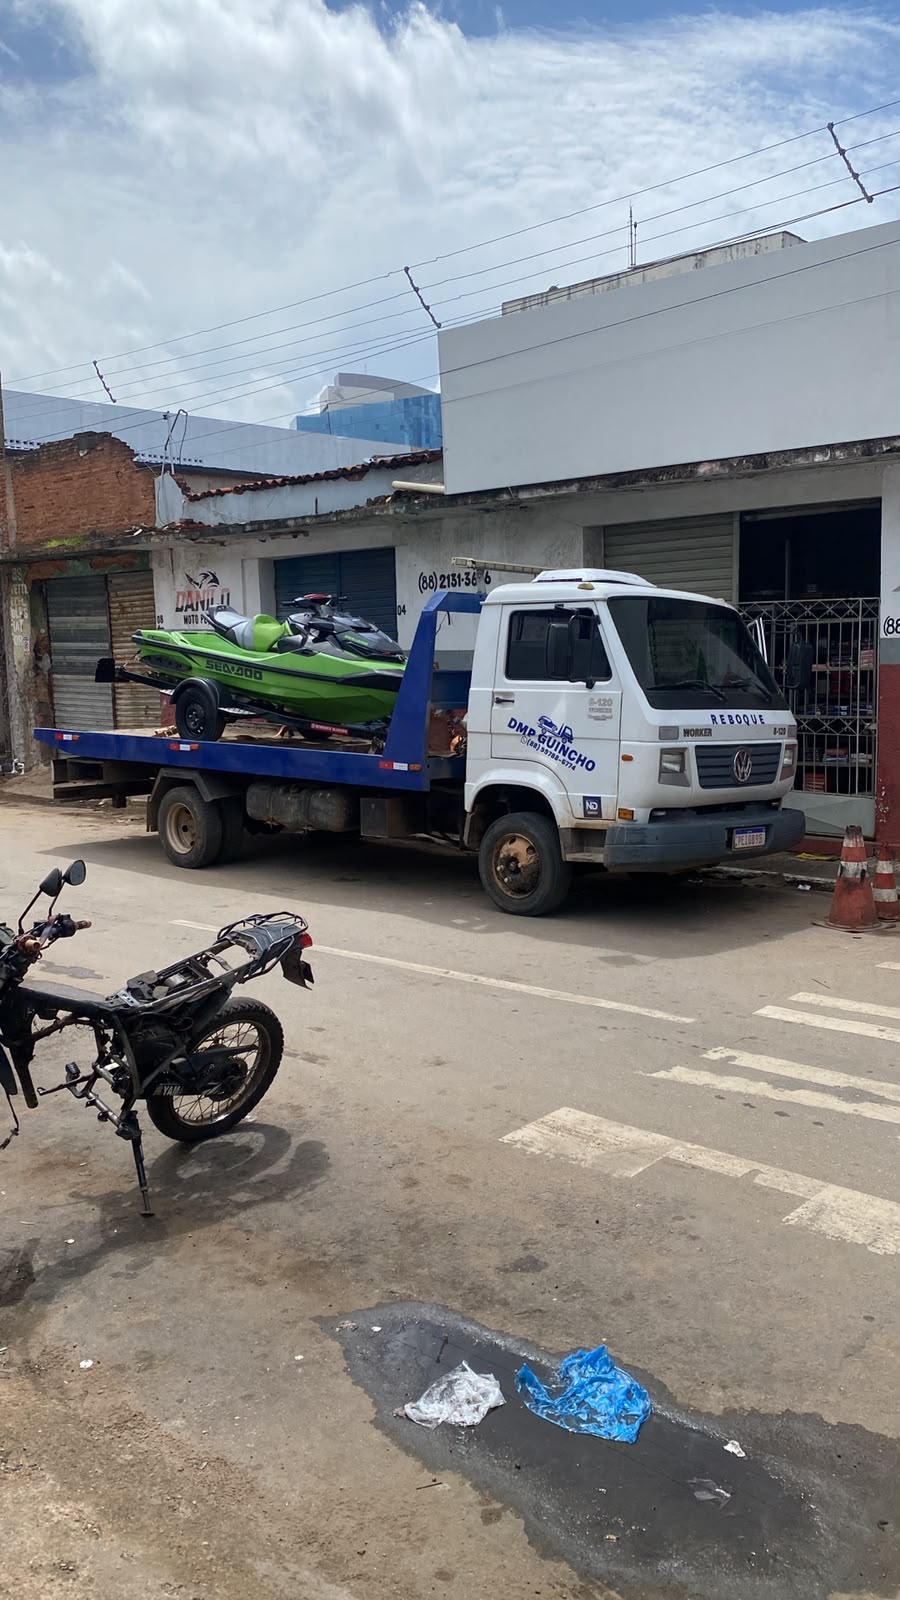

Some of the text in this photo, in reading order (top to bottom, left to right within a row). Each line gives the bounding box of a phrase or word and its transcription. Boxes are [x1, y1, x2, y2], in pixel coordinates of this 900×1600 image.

[418, 571, 438, 594] (88)
[710, 714, 766, 726] REBOQUE
[683, 727, 713, 738] WORKER
[507, 717, 596, 772] DMP GUINCHO
